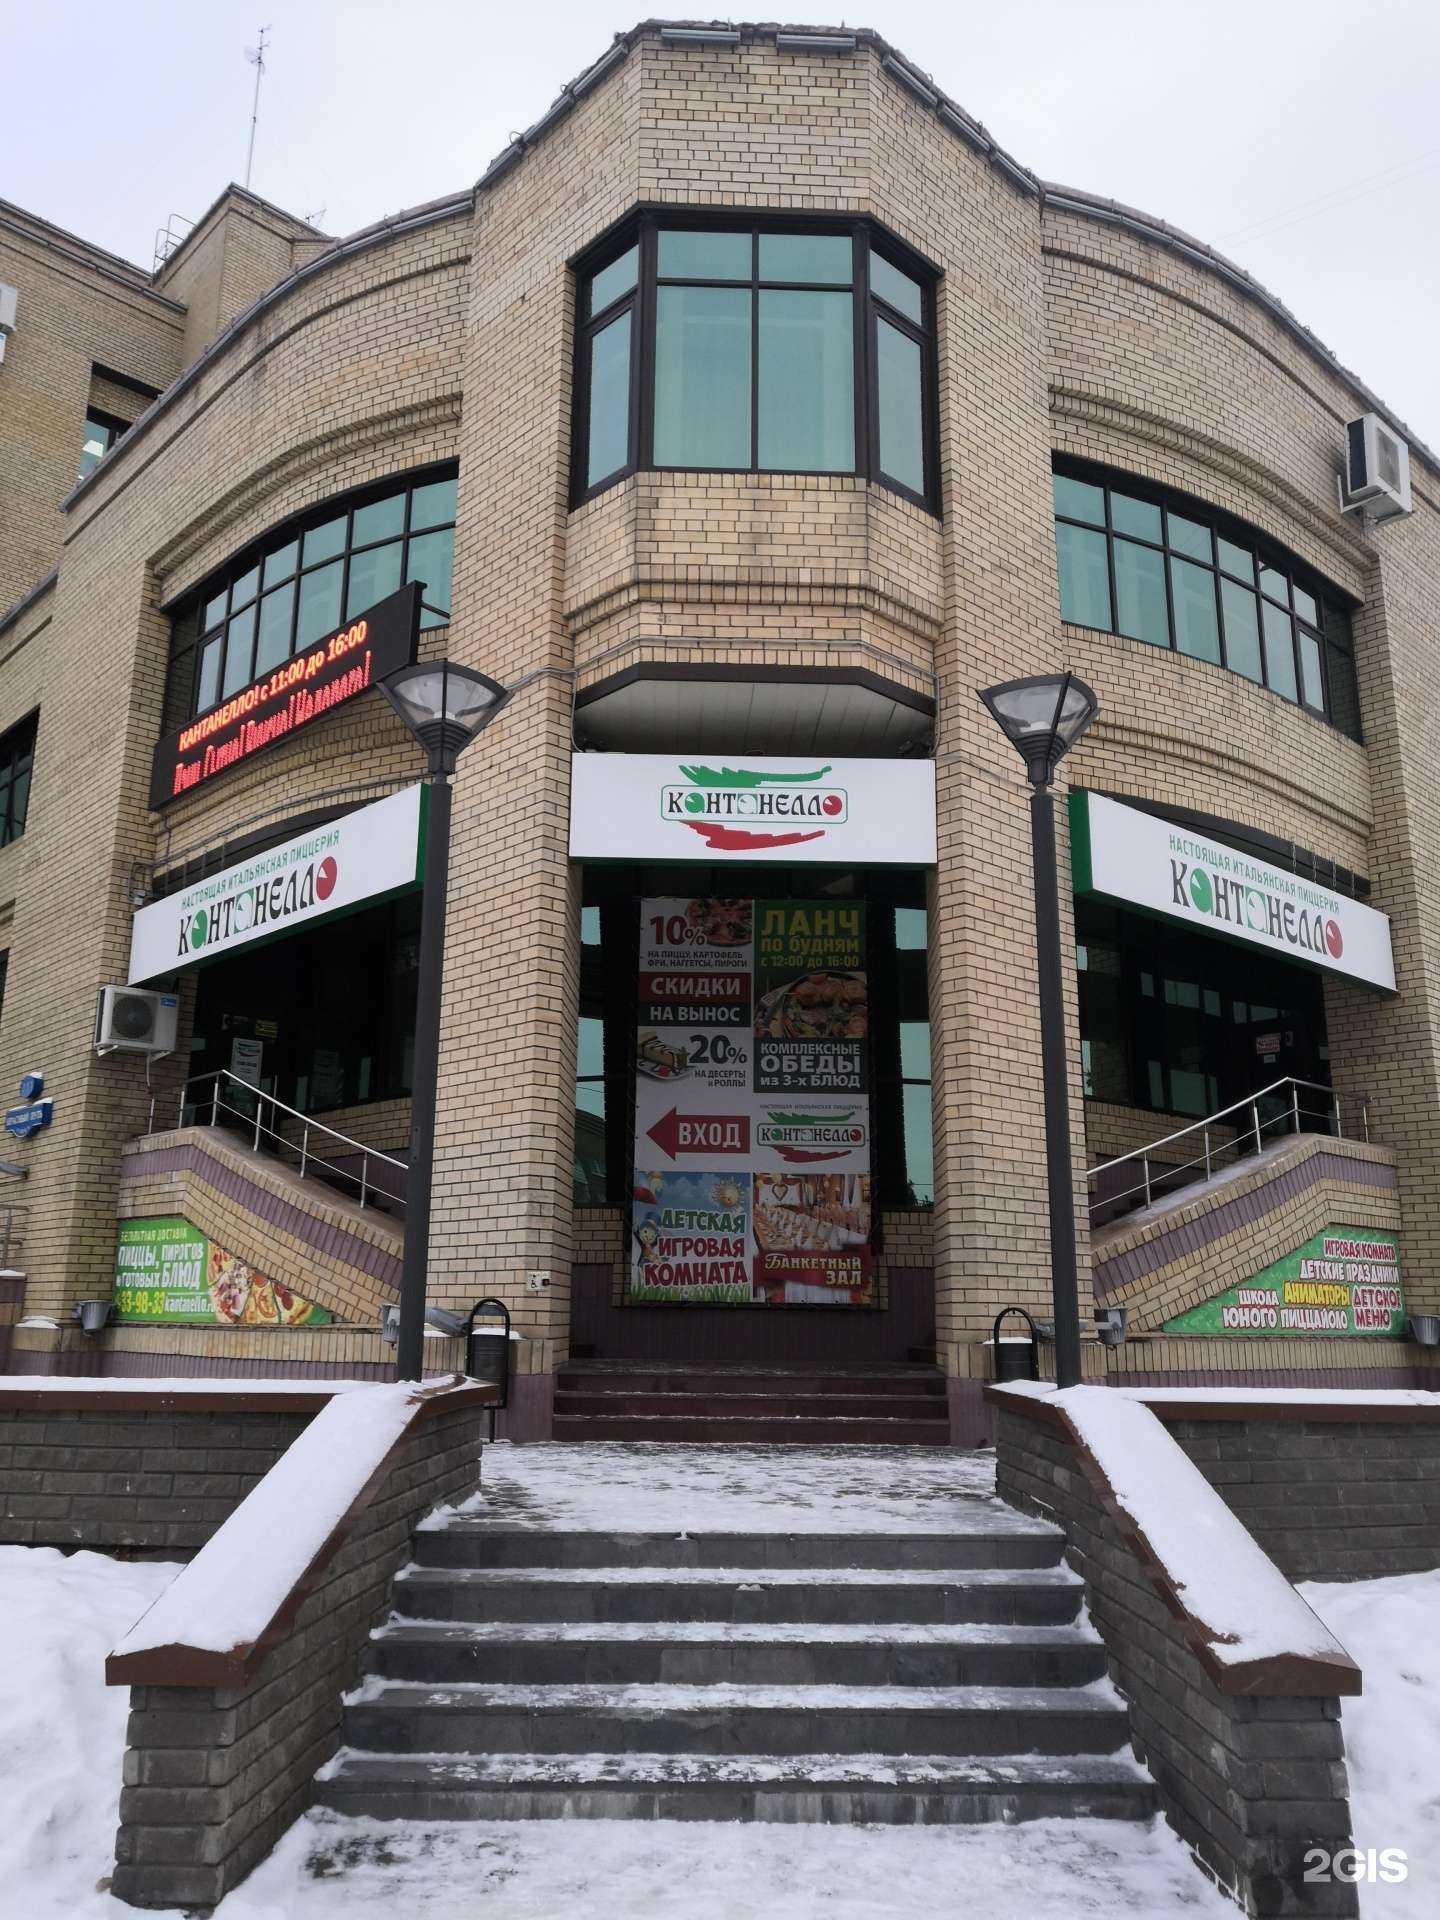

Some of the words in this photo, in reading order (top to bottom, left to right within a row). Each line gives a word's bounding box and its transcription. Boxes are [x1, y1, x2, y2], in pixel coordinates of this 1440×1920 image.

[179, 685, 260, 752] КАНТАНЕЛЛО!
[269, 659, 304, 696] 11:00
[305, 651, 324, 680] до
[327, 620, 367, 661] 16:00
[181, 881, 227, 910] НАСТОЯЩАЯ
[227, 852, 288, 890] ИТАЛЬЯНСКАЯ
[290, 829, 340, 862] ПИЦЦЕРИЯ
[1169, 833, 1231, 872] НАСТОЯЩАЯ
[1233, 857, 1296, 897] ИТАЛЬЯНСКАЯ
[1298, 886, 1340, 914] ПИЦЦЕРИЯ
[650, 915, 707, 946] 10%
[760, 909, 859, 935] ЛАНЧ
[648, 951, 660, 959] НА
[693, 951, 743, 959] КАРТОФЕЛЬ
[761, 938, 783, 953] по
[791, 935, 859, 956] будням
[715, 960, 747, 968] ПИРОГИ
[772, 956, 803, 968] 12:00
[807, 958, 823, 969] до
[827, 956, 859, 968] 16:00
[651, 977, 741, 998] СКИДКИ
[650, 1006, 673, 1022] НА
[678, 1006, 741, 1022] ВЫНОС
[689, 1034, 748, 1064] 20%
[760, 1043, 860, 1056] КОМПЛЕКСНЫЕ
[695, 1070, 706, 1079] НА
[707, 1070, 746, 1080] ДЕСЕРТЫ
[760, 1056, 861, 1075] ОБЕДЫ
[811, 1074, 861, 1088] БЛЮД
[678, 1122, 741, 1148] ВХОД
[661, 1208, 746, 1234] ДЕТСКАЯ
[118, 1244, 160, 1270] ПИЦЦЫ,
[161, 1242, 204, 1261] ПИРОГОВ
[658, 1237, 745, 1258] ИГРОВАЯ
[1324, 1239, 1361, 1259] ИГРОВАЯ
[1362, 1244, 1396, 1261] КОМНАТА
[122, 1272, 160, 1288] ГОТОВЫХ
[161, 1261, 202, 1290] БЛЮД
[643, 1261, 749, 1287] КОМНАТА
[825, 1270, 861, 1285] ЗАЛ
[1300, 1260, 1345, 1281] ДЕТСКИЕ
[1346, 1263, 1400, 1284] ПРАЗДНИКИ
[1238, 1289, 1279, 1306] ШКОЛА
[1284, 1281, 1350, 1306] АНИМАТОРЫ
[1223, 1308, 1278, 1329] ЮНОГО
[1280, 1308, 1348, 1330] ПИЦЦАЙОЛО
[1355, 1309, 1391, 1329] МЕНЮ
